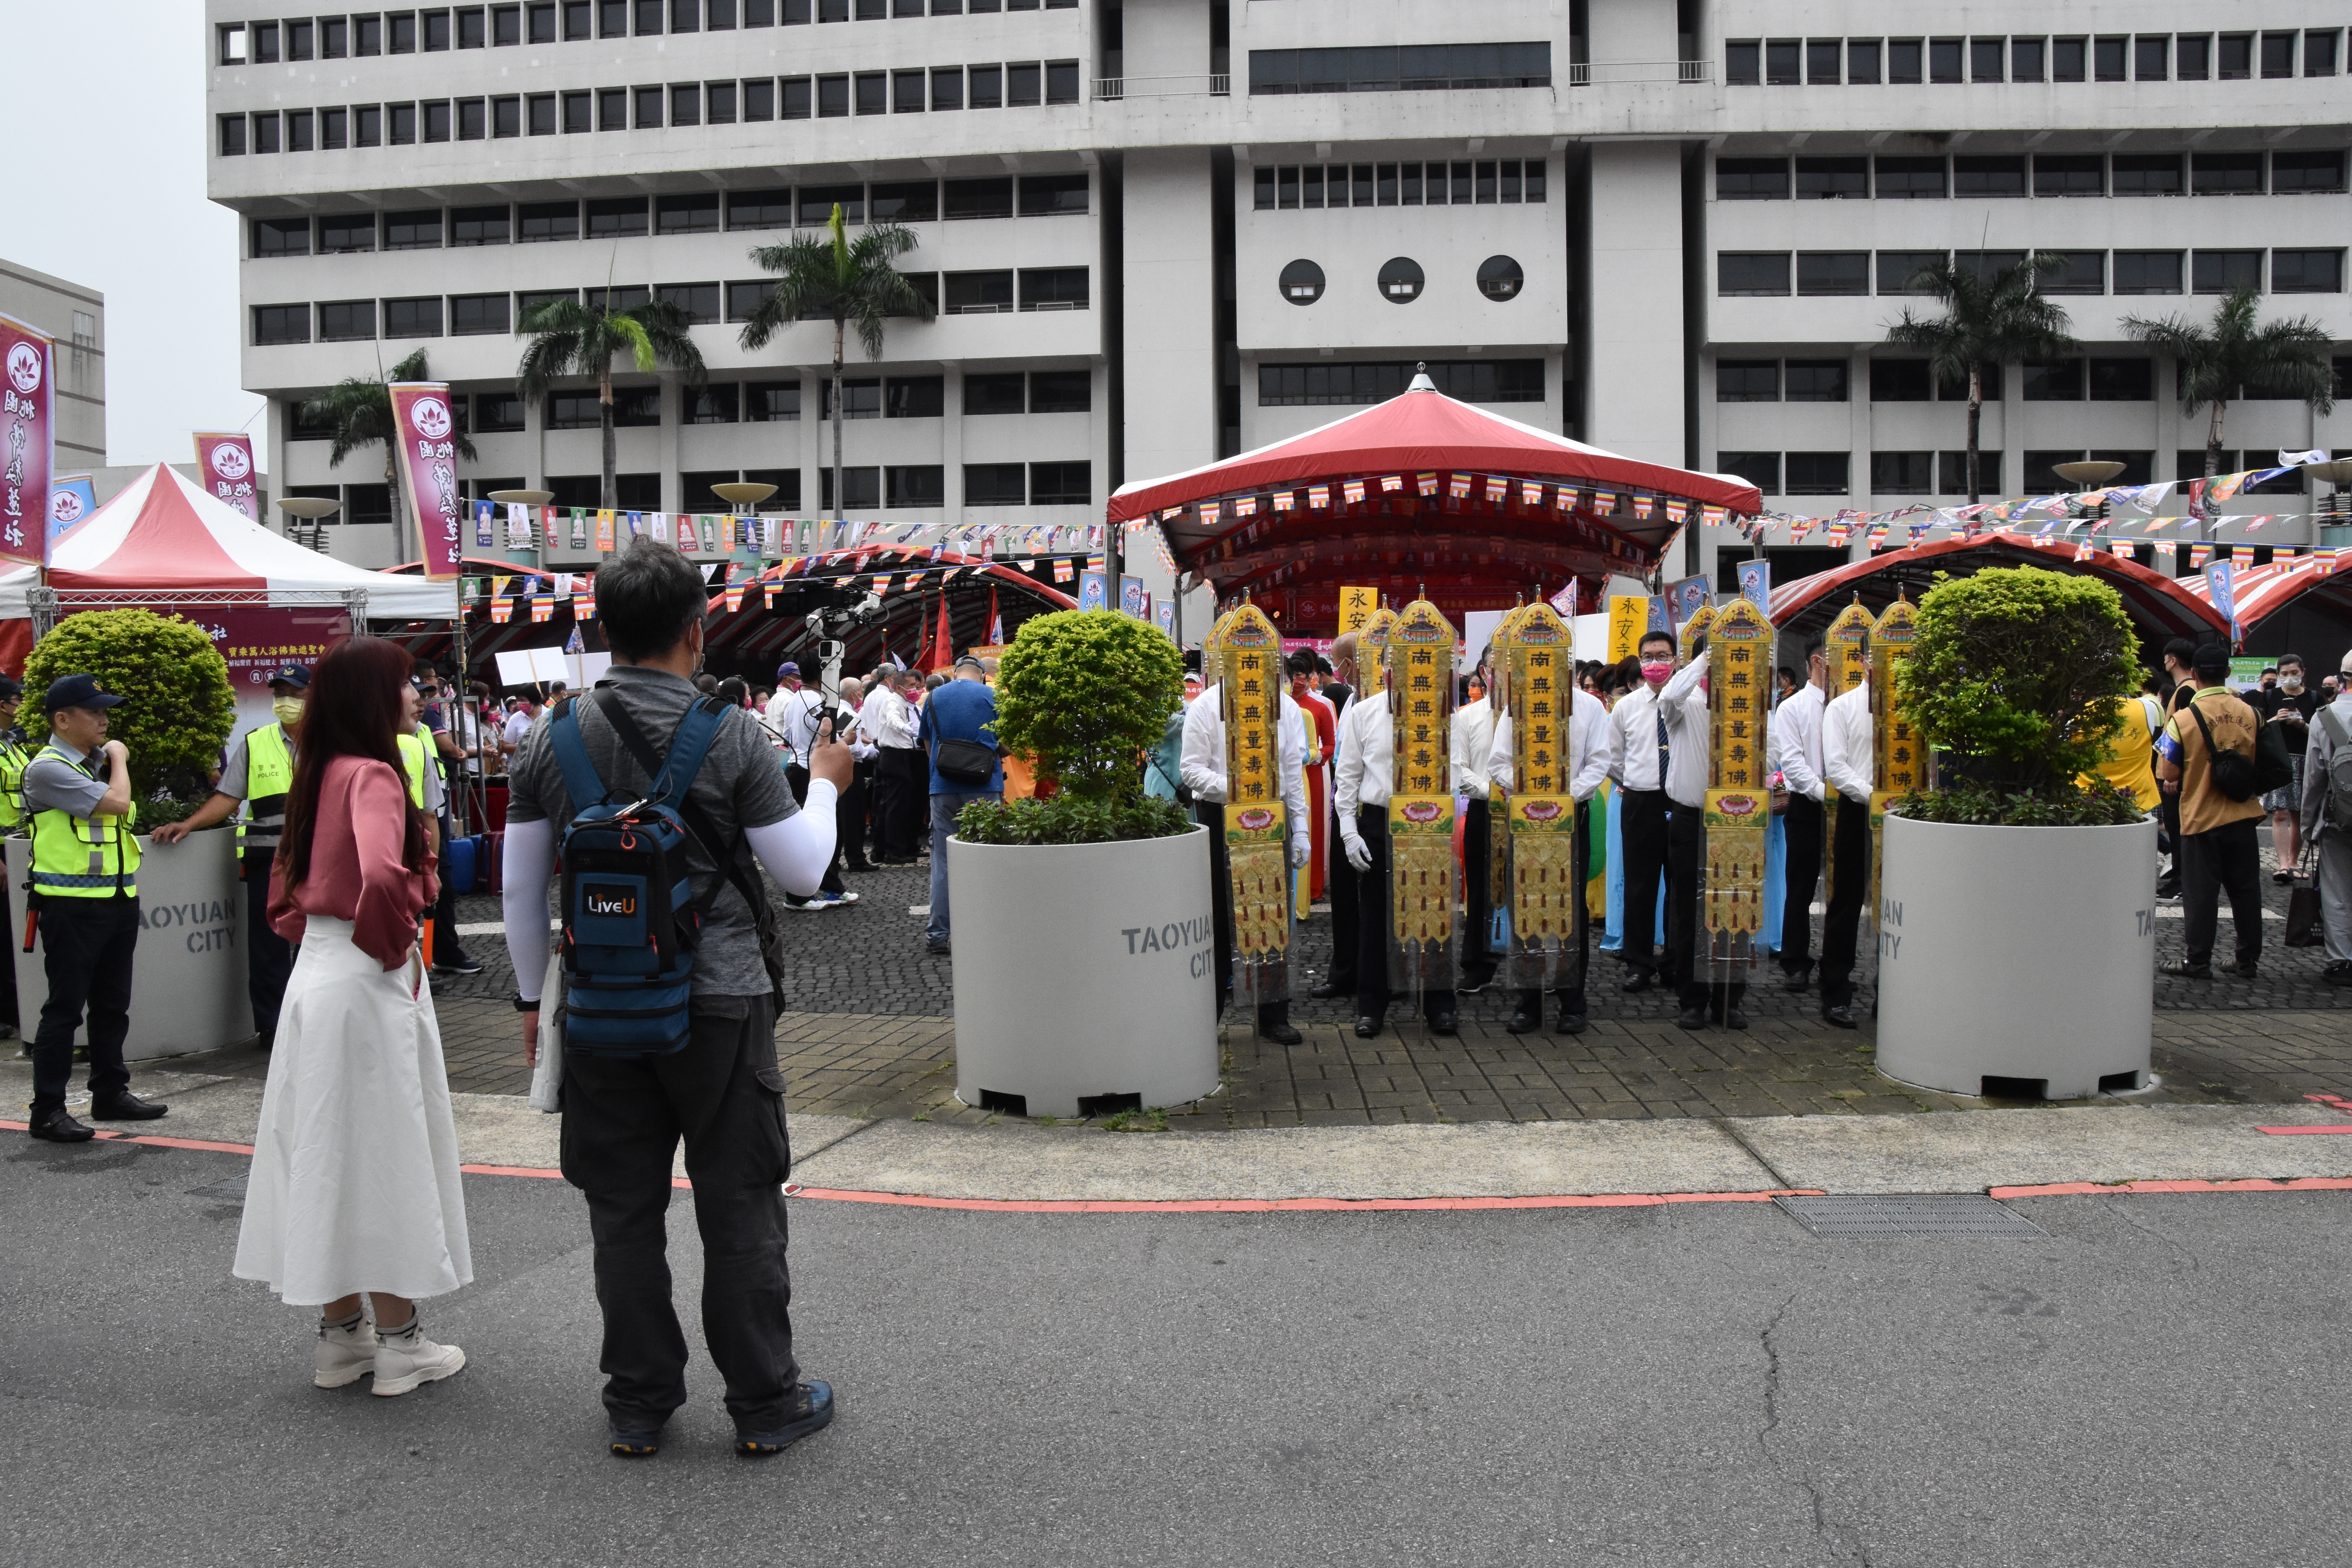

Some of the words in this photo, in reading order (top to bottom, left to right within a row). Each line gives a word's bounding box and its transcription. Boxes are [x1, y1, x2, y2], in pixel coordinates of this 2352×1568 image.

[1347, 589, 1368, 630] 永安
[1616, 598, 1639, 661] 永安寺
[1241, 654, 1263, 799] 南無無量壽佛
[1411, 649, 1432, 792] 南無無量壽佛
[1530, 651, 1552, 791] 南無無量壽佛
[1728, 647, 1750, 786] 南無無量壽佛
[1891, 649, 1912, 786] 量壽佛
[186, 927, 234, 953] CITY
[588, 894, 635, 914] LiveU
